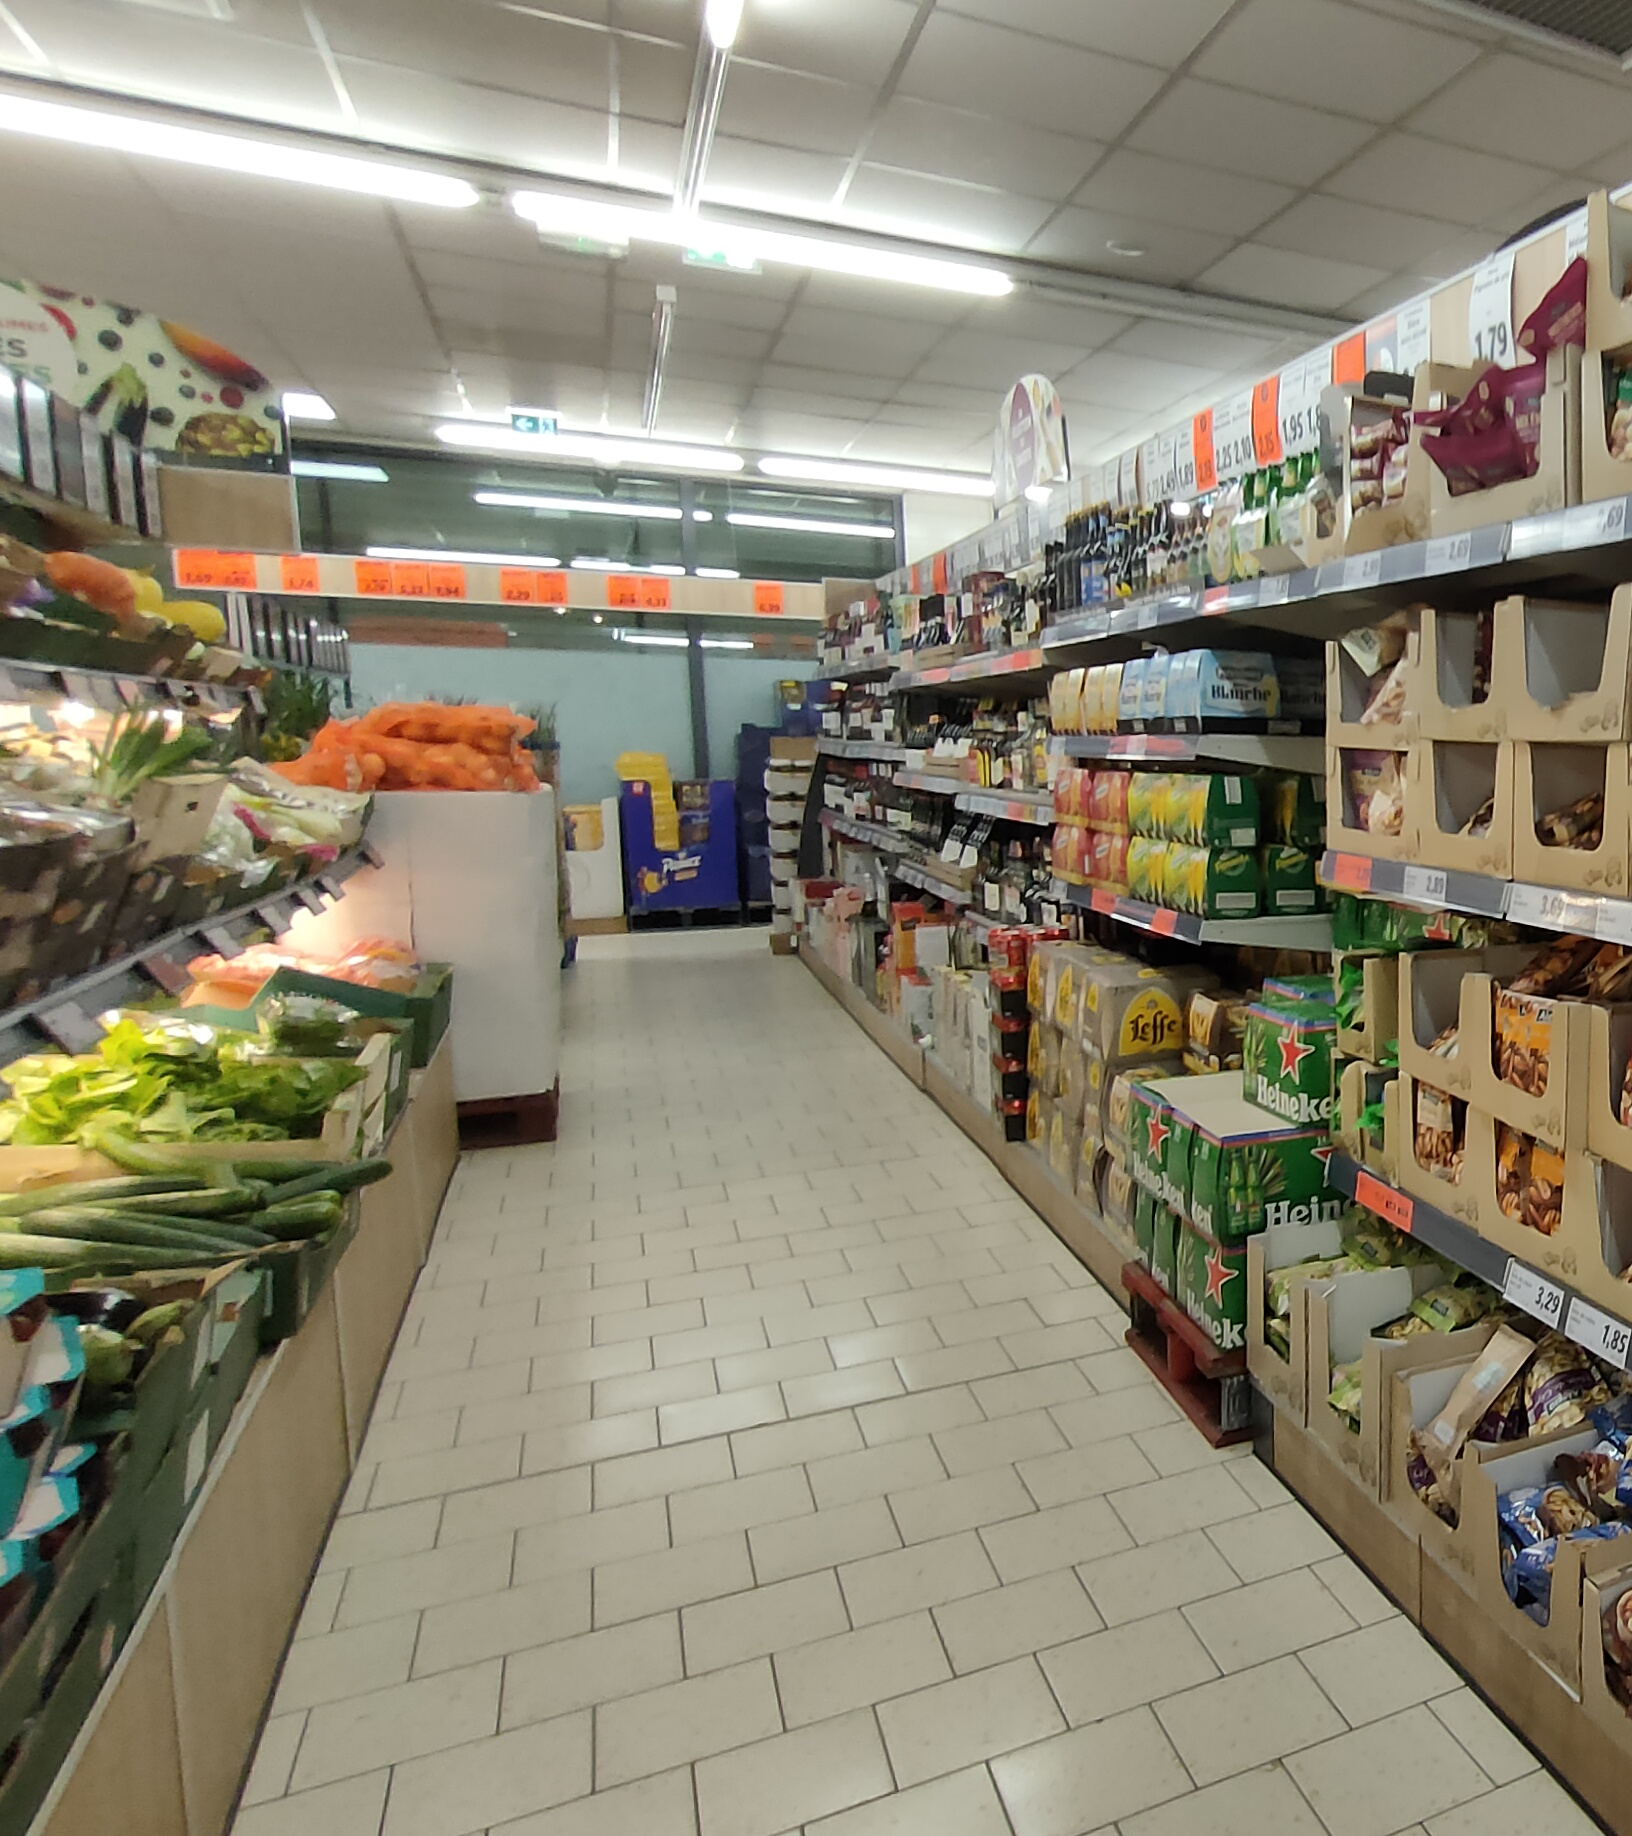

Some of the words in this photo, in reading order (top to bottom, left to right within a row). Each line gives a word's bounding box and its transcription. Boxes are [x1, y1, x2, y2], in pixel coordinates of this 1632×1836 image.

[1474, 321, 1508, 361] 179
[1128, 1010, 1178, 1046] Leffe
[1535, 1286, 1561, 1315] 3,29
[1602, 1323, 1629, 1355] 1,85
